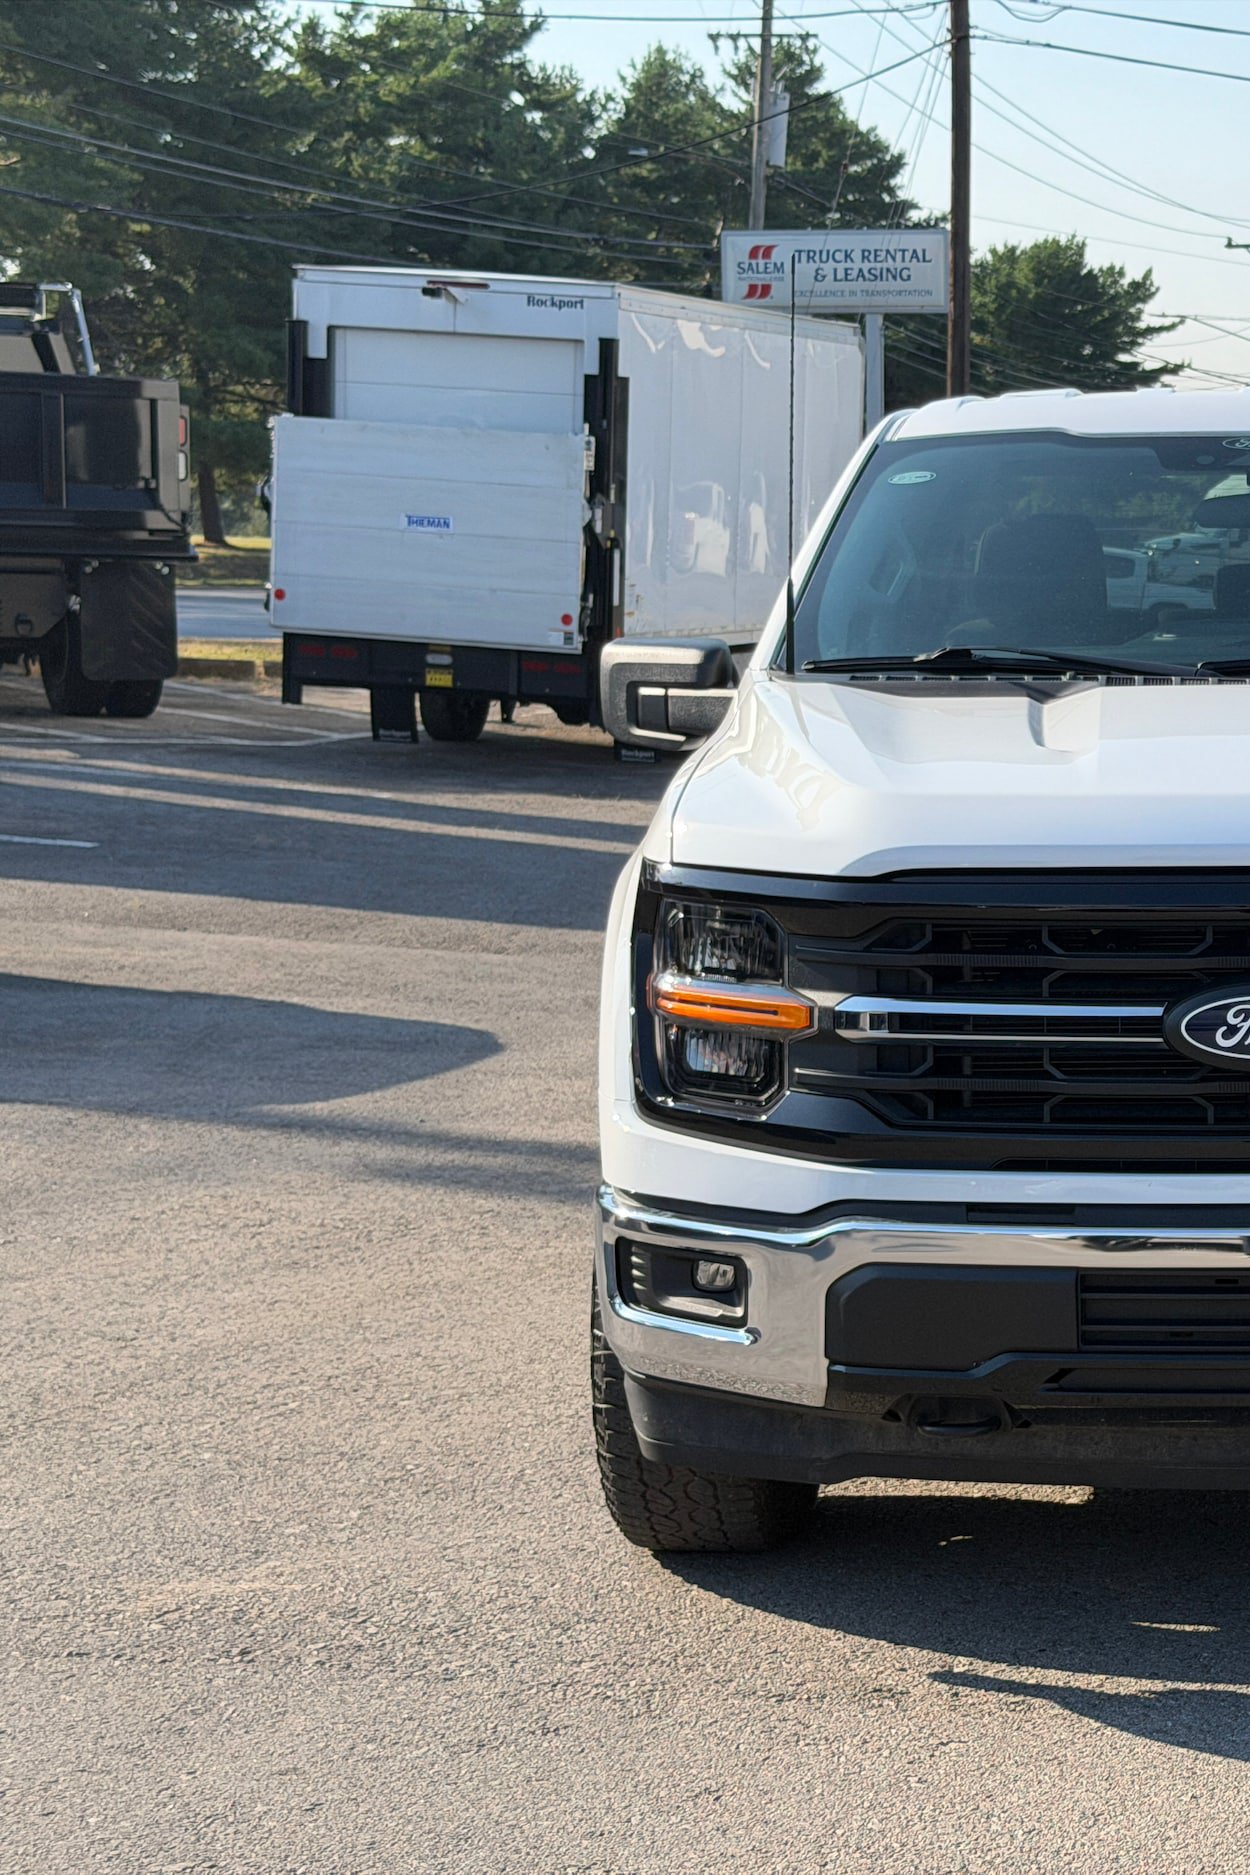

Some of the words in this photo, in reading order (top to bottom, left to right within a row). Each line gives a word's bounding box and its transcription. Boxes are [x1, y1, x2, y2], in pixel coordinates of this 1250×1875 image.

[795, 248, 856, 264] TRUCK
[860, 248, 933, 264] RENTAL
[736, 261, 785, 275] SALEM
[813, 267, 828, 283] &
[832, 267, 912, 282] LEASING
[794, 289, 846, 298] EXCELLENCE
[860, 289, 933, 298] TRANSPORTATION
[526, 295, 584, 311] Rockport
[405, 514, 451, 529] THIEMAN
